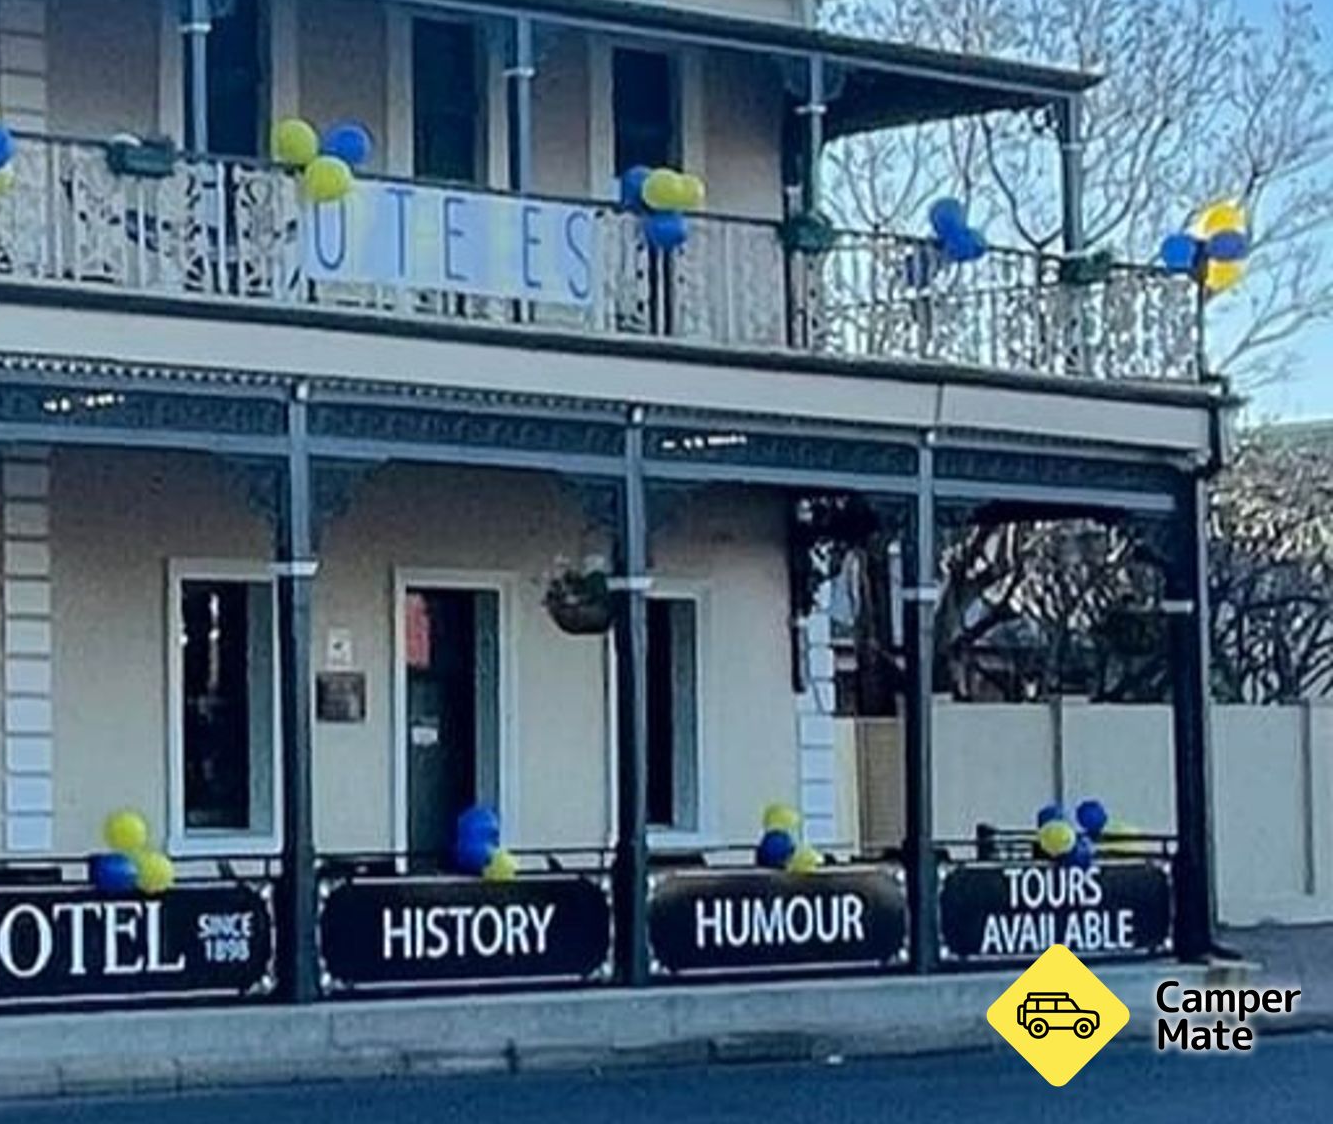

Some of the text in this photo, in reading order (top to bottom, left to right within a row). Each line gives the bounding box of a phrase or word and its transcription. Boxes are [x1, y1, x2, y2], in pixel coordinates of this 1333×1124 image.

[1003, 866, 1103, 909] TOURS
[197, 910, 253, 938] SINCE
[381, 902, 556, 960] HISTORY
[694, 894, 866, 949] HUMOUR
[981, 908, 1135, 955] AVAILABLE
